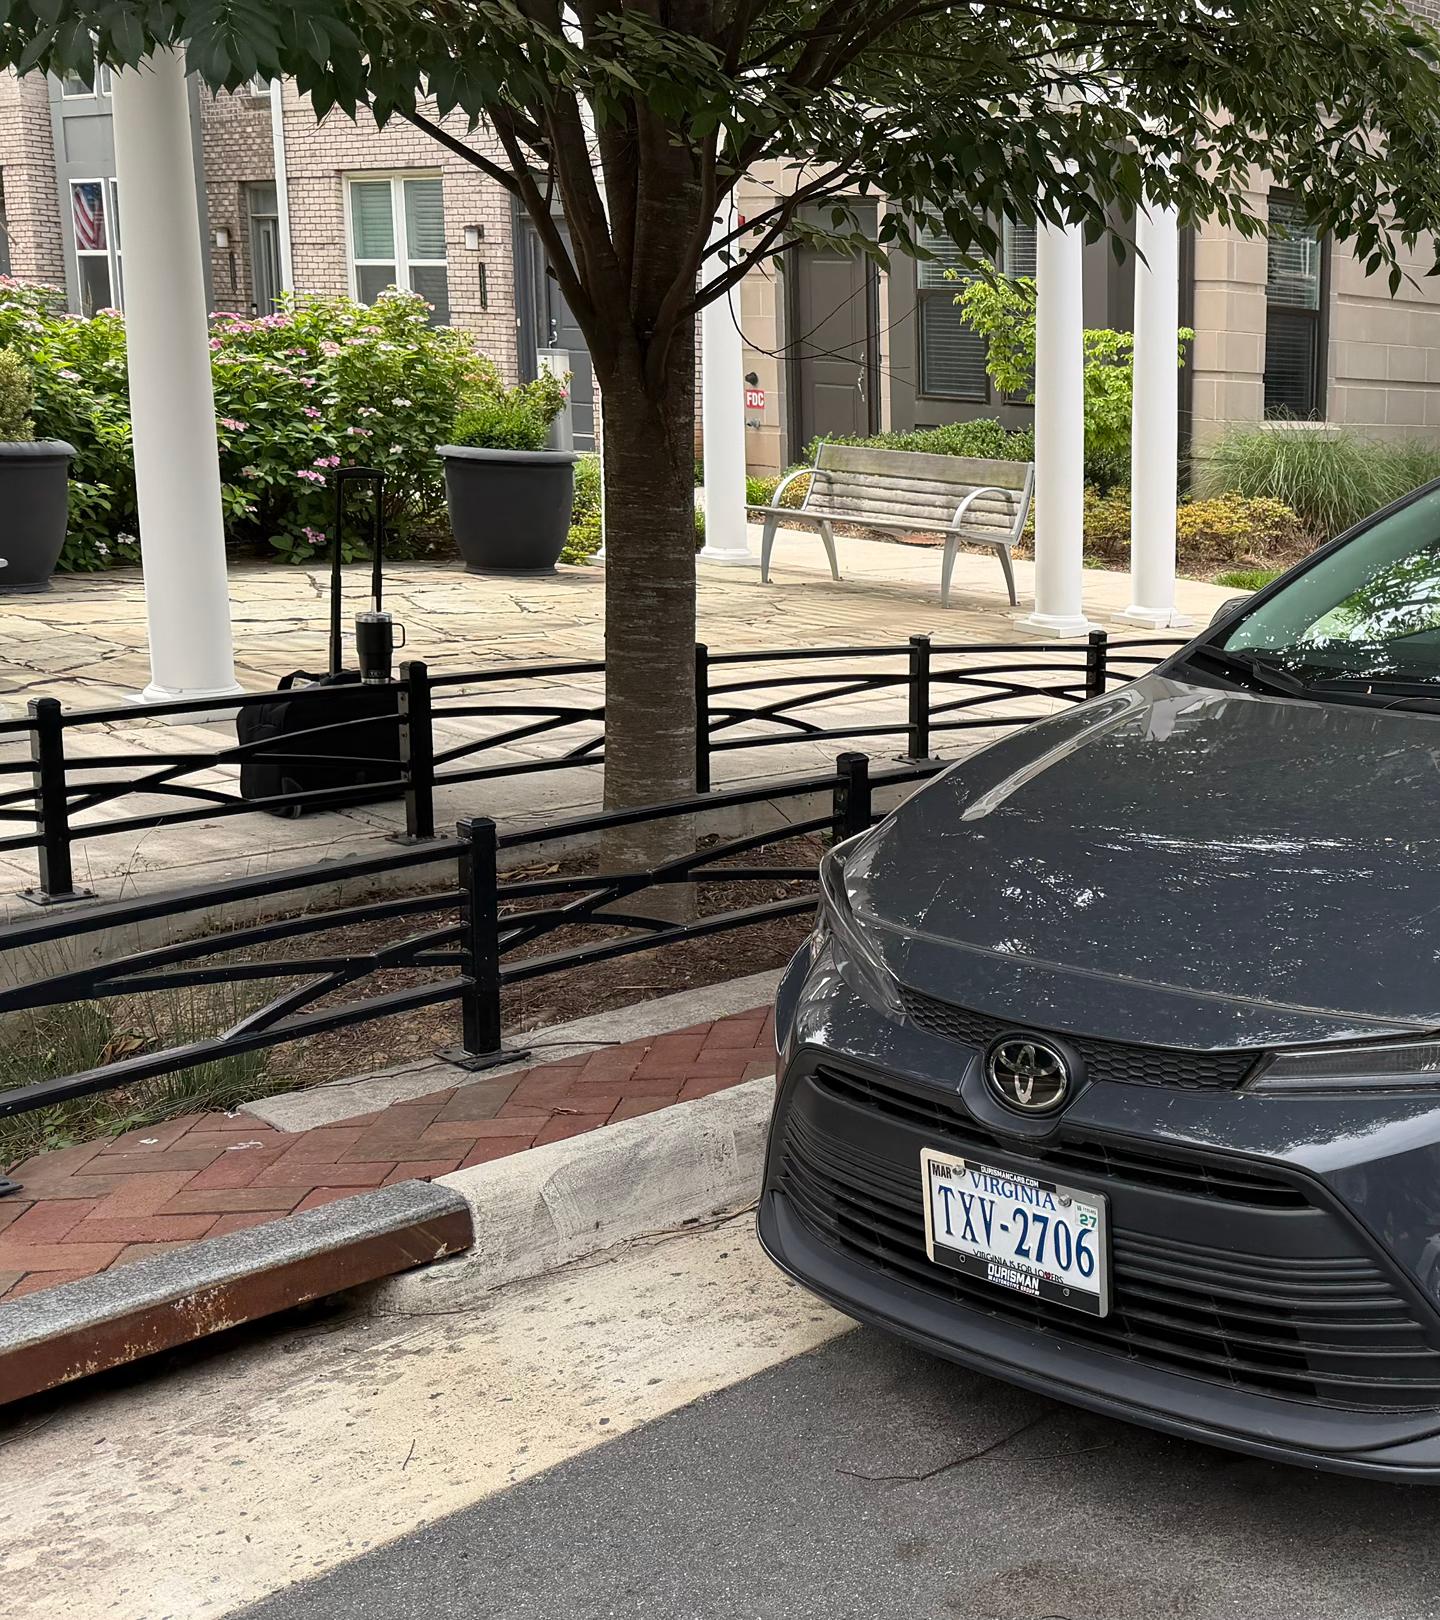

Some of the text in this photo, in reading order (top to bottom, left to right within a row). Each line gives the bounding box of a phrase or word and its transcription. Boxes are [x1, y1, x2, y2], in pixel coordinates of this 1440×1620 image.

[746, 391, 764, 407] FDC
[931, 1163, 952, 1180] MAR
[980, 1165, 1039, 1188] OURISMANCARS.COM
[969, 1170, 1057, 1212] VIRGINIA
[1080, 1213, 1097, 1228] 27
[937, 1184, 1095, 1278] TXV-2706
[972, 1248, 1007, 1266] VIRGINIA
[987, 1263, 1040, 1290] OURISMAN
